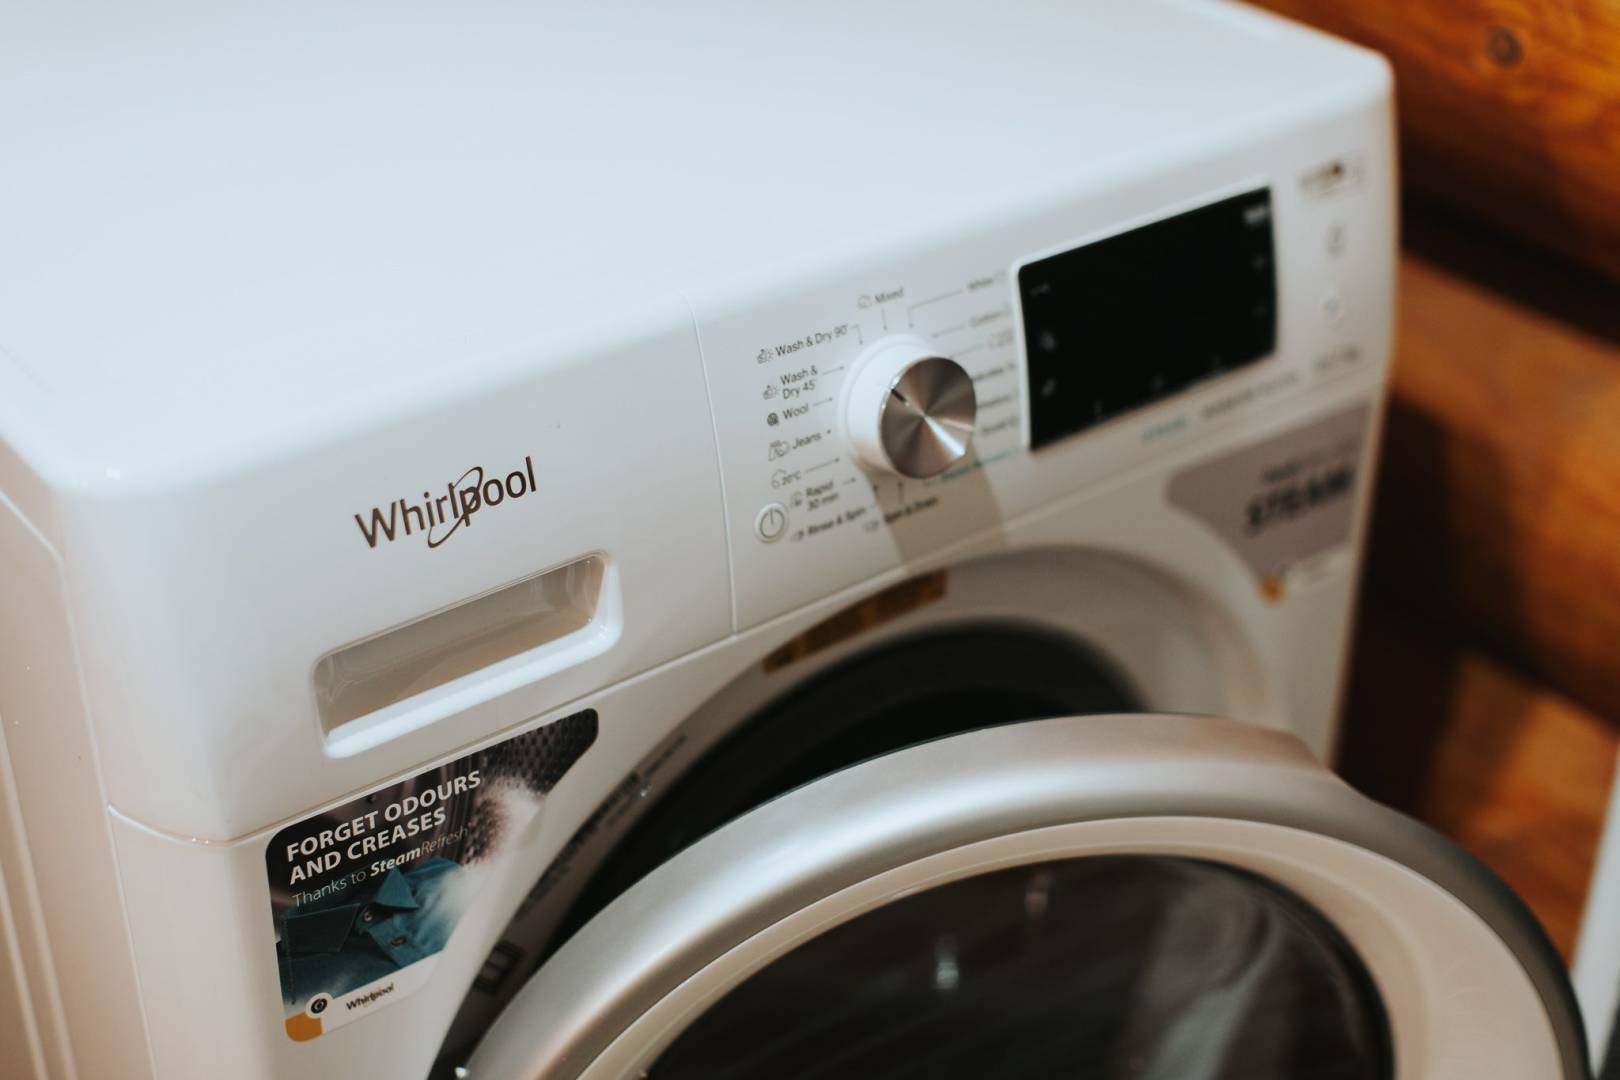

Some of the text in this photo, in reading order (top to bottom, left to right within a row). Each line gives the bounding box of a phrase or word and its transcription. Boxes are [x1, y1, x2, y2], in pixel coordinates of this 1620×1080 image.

[875, 287, 904, 304] Mixed
[776, 340, 804, 356] Wash
[806, 336, 814, 347] &
[814, 332, 832, 344] Dry
[780, 365, 818, 385] Wash &
[782, 387, 800, 399] Dry
[782, 403, 809, 419] Wool
[792, 432, 822, 449] Jeans
[806, 480, 834, 497] Rapid
[354, 455, 537, 549] Whirlpool
[808, 520, 835, 535] Rinse
[287, 770, 481, 862] FORGET ODOURS
[289, 807, 446, 886] AND CREASES
[292, 826, 468, 907] Thanks to SteamRefresh
[346, 982, 394, 1010] Whirlpool
